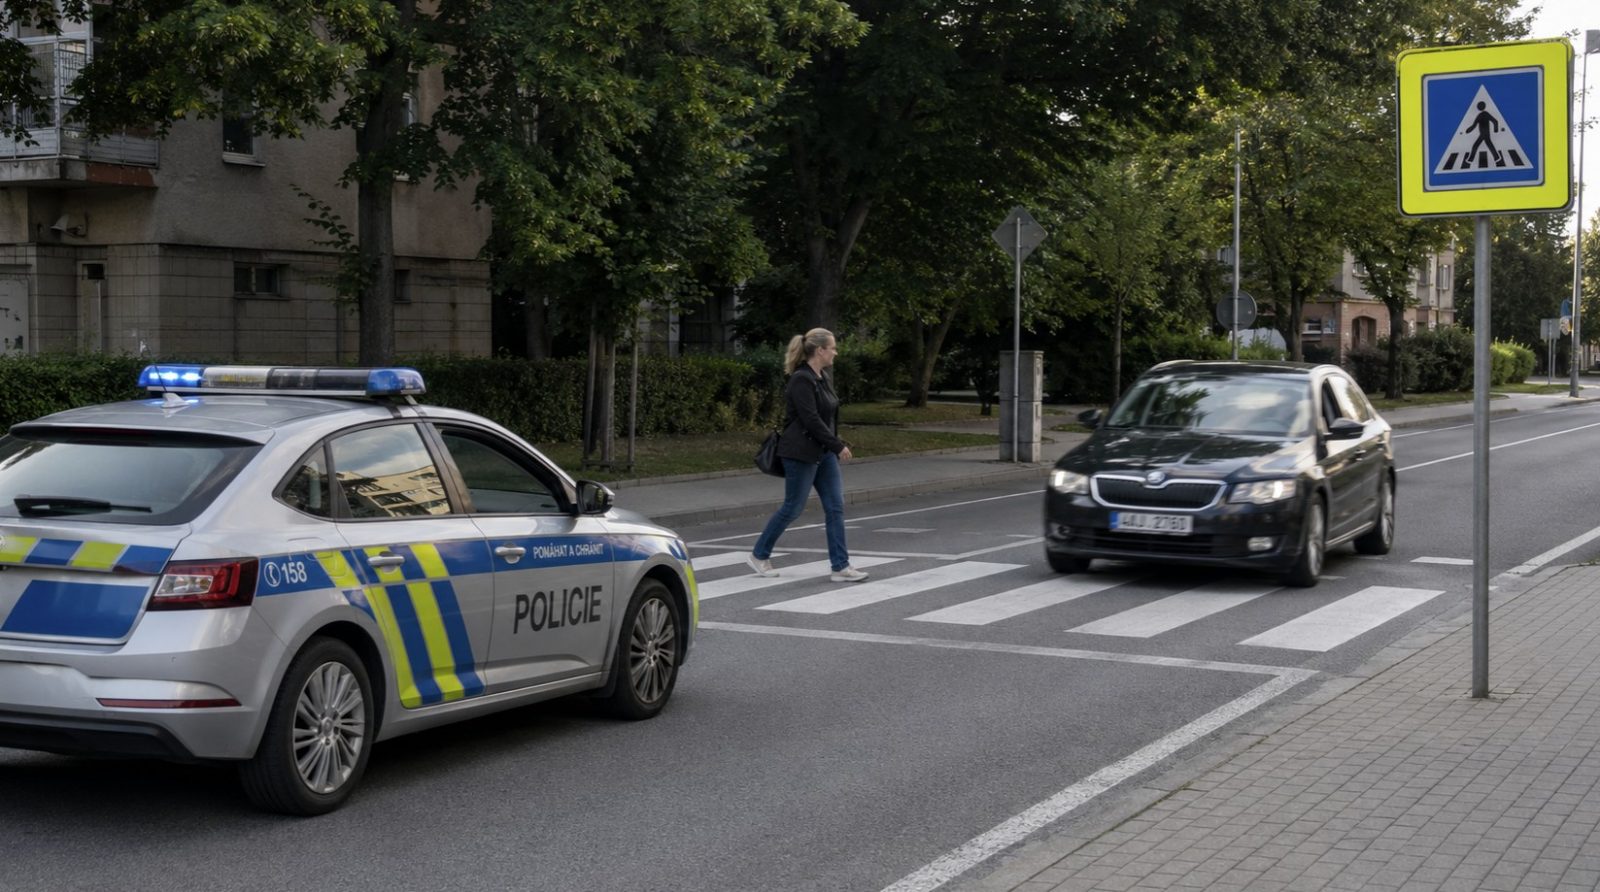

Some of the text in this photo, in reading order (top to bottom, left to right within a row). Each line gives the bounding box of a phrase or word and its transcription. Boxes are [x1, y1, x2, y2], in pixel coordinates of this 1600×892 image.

[532, 542, 568, 559] POMÁHAT
[569, 545, 575, 557] A
[281, 561, 308, 584] 158
[513, 585, 602, 635] POLICIE
